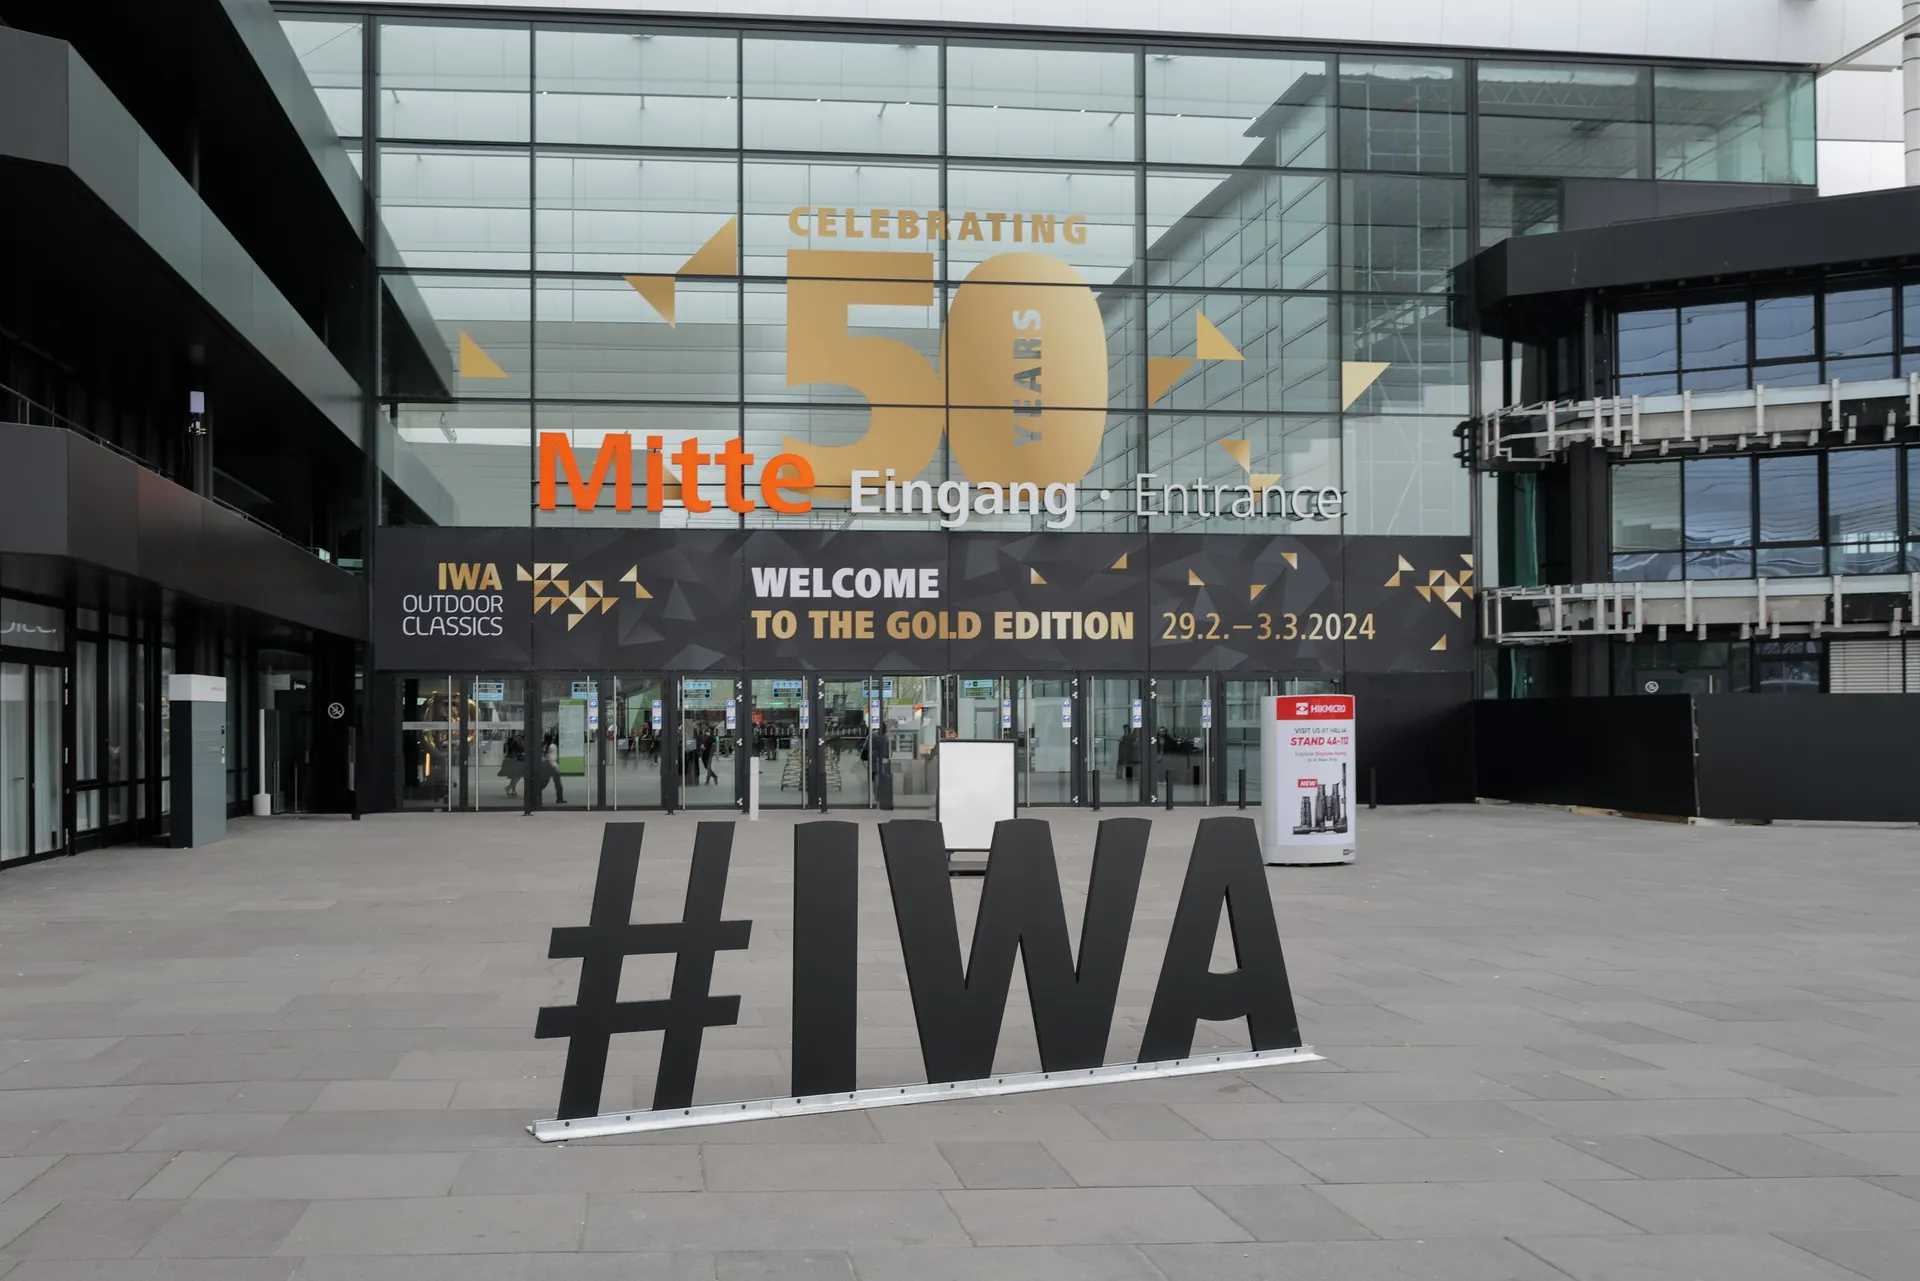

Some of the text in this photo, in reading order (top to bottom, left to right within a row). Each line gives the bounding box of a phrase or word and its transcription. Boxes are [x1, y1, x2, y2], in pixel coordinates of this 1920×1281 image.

[788, 206, 1087, 245] CELEBRATING
[782, 249, 1109, 500] 50
[1012, 308, 1042, 448] YEARS
[537, 431, 815, 513] Mitte
[850, 467, 1079, 530] Eingang
[1135, 472, 1343, 520] Entrance
[438, 562, 503, 591] IWA
[751, 567, 939, 599] WELCOME
[402, 594, 504, 613] OUTDOOR
[402, 616, 504, 636] CLASSICS
[751, 610, 1134, 640] TO THE GOLD EDITION
[1310, 704, 1346, 713] HIKMICRO
[1290, 737, 1325, 746] STAND
[535, 818, 1303, 1120] #IWA
